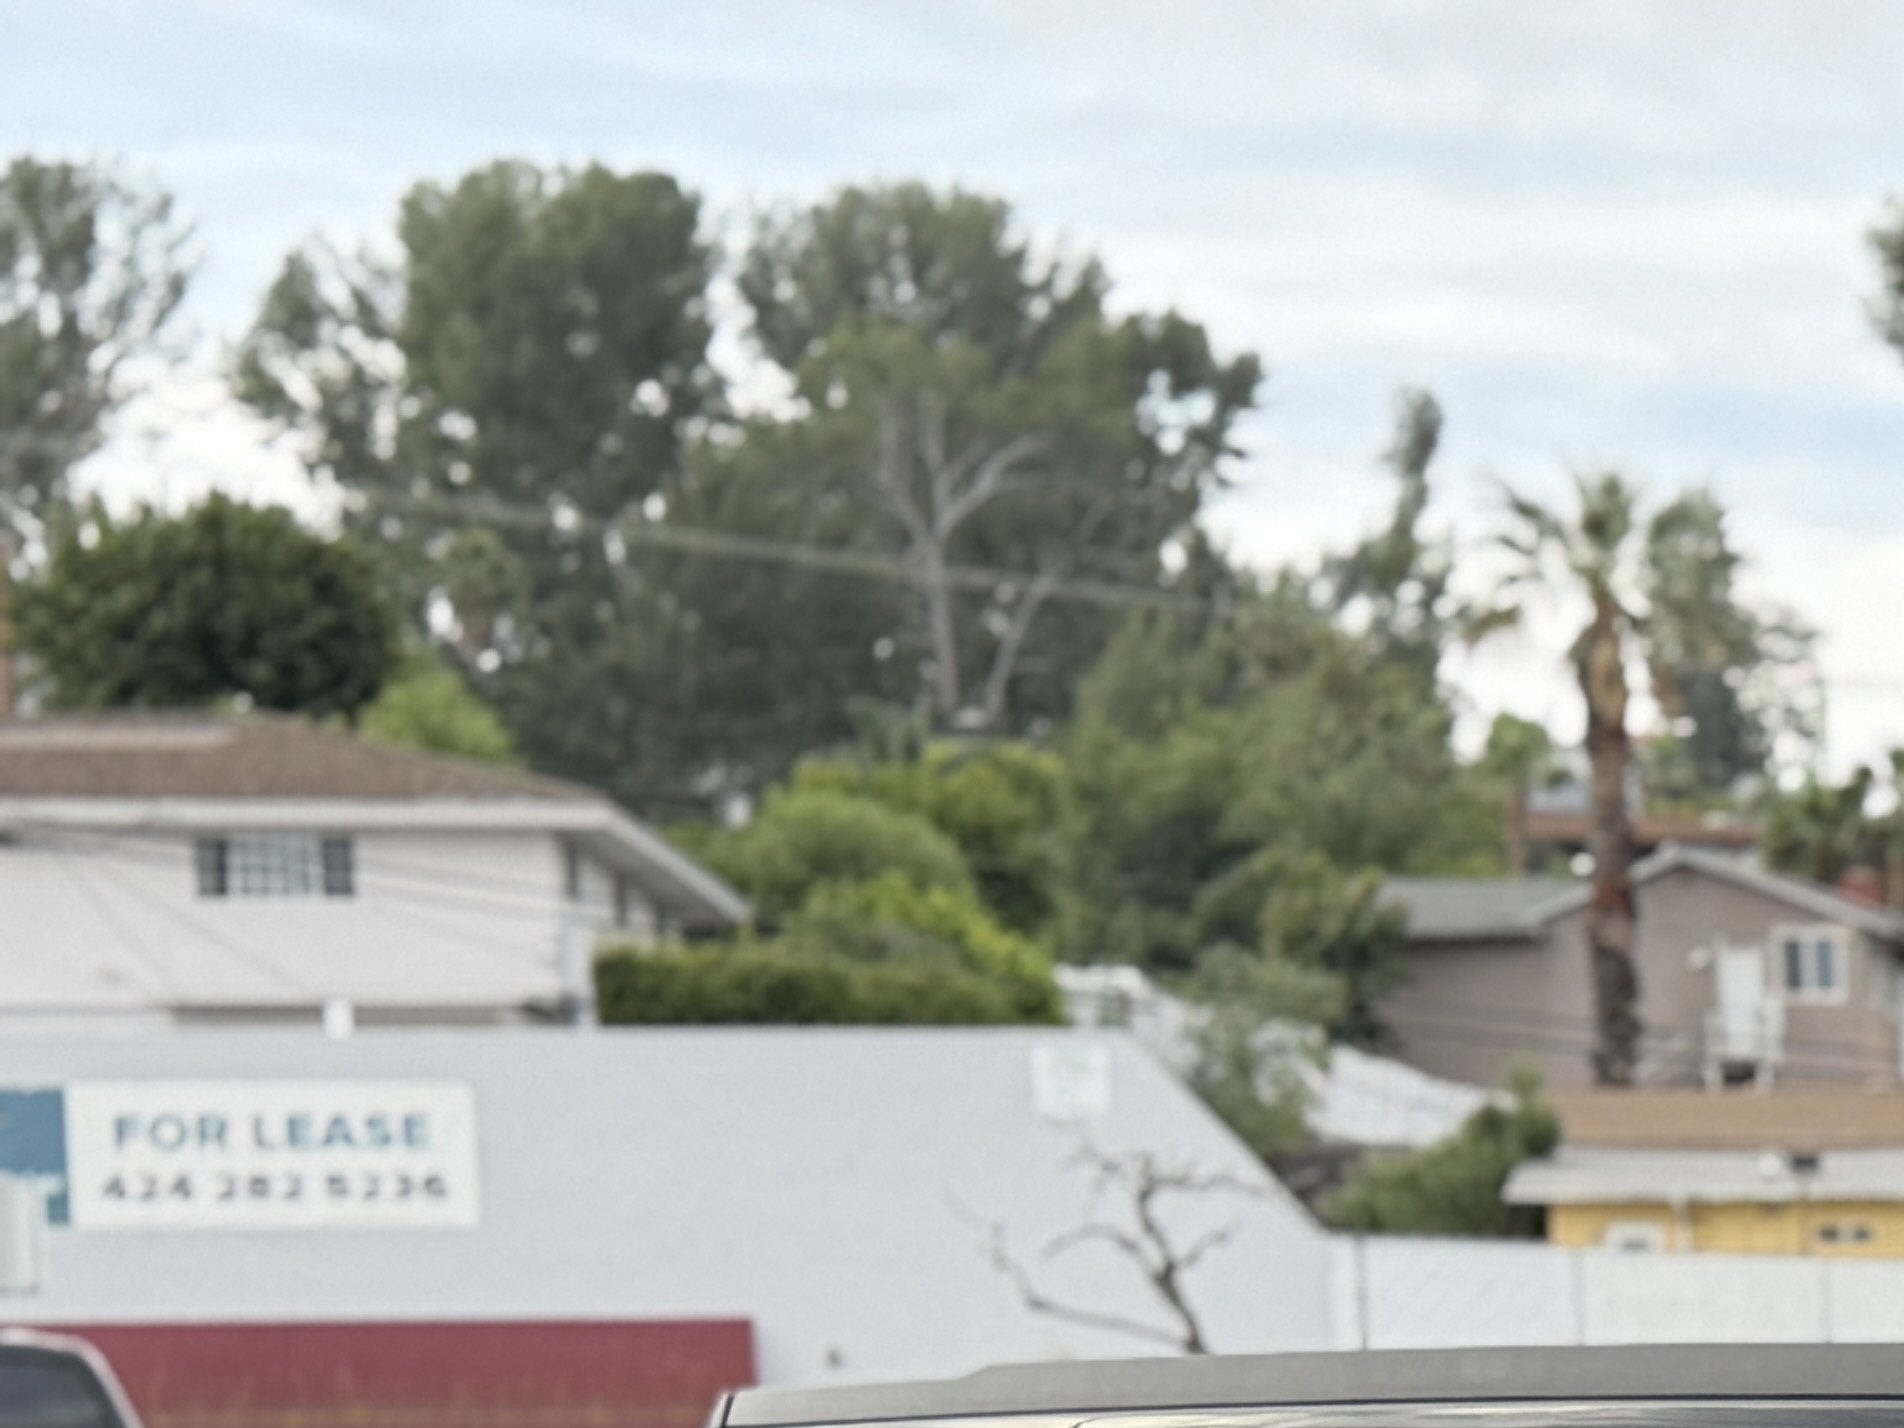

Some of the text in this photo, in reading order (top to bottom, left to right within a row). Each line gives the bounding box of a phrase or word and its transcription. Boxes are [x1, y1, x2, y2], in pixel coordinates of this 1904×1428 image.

[113, 1112, 431, 1151] FOR LEASE
[103, 1173, 193, 1201] 424
